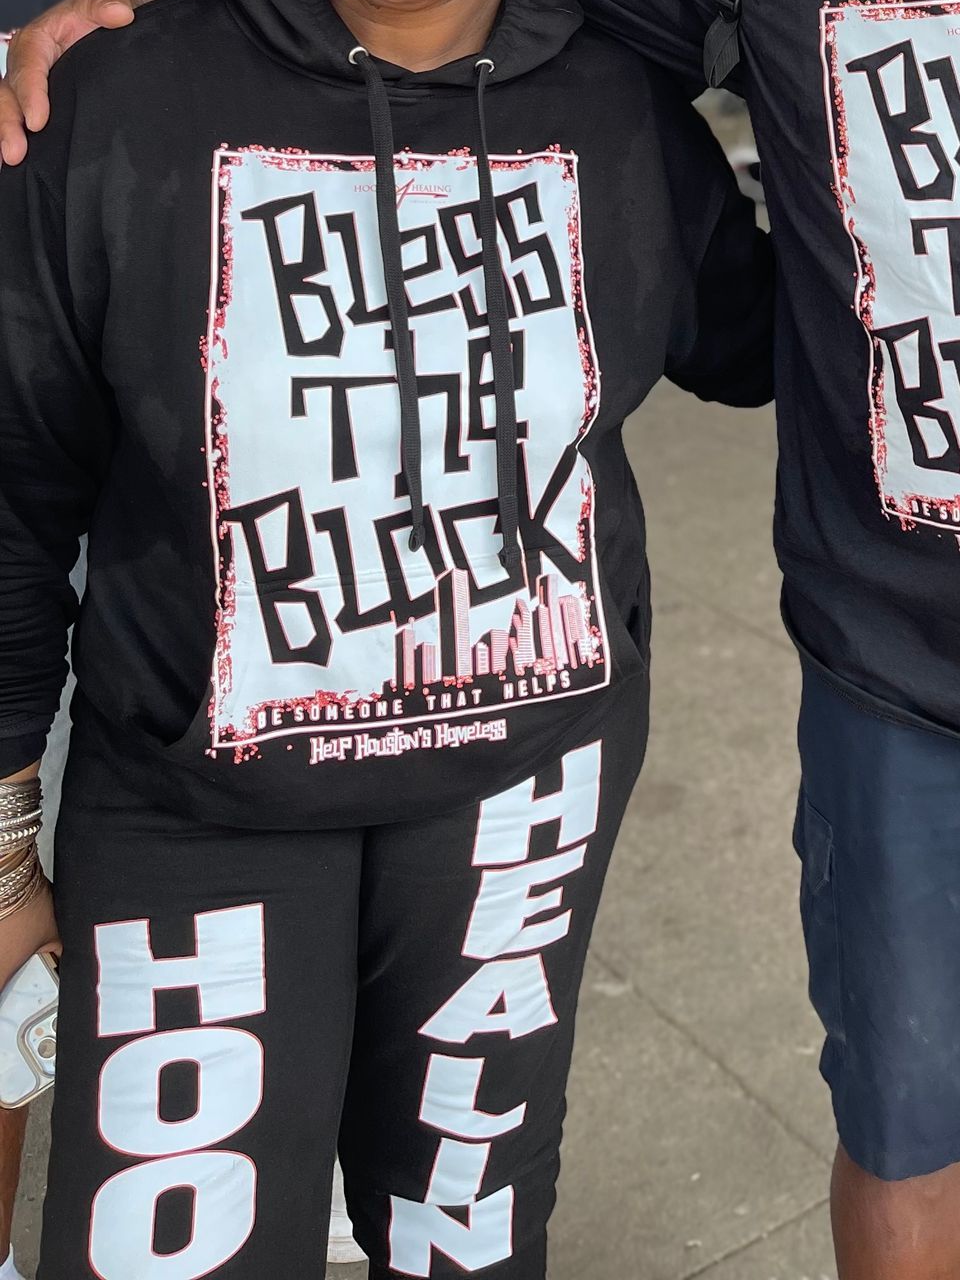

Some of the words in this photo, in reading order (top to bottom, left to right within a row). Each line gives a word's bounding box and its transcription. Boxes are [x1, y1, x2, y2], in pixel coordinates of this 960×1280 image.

[412, 185, 452, 193] HEALING
[257, 706, 283, 730] BE
[293, 700, 404, 722] SOMEONE
[427, 689, 482, 711] THAT
[503, 670, 571, 700] HELPS
